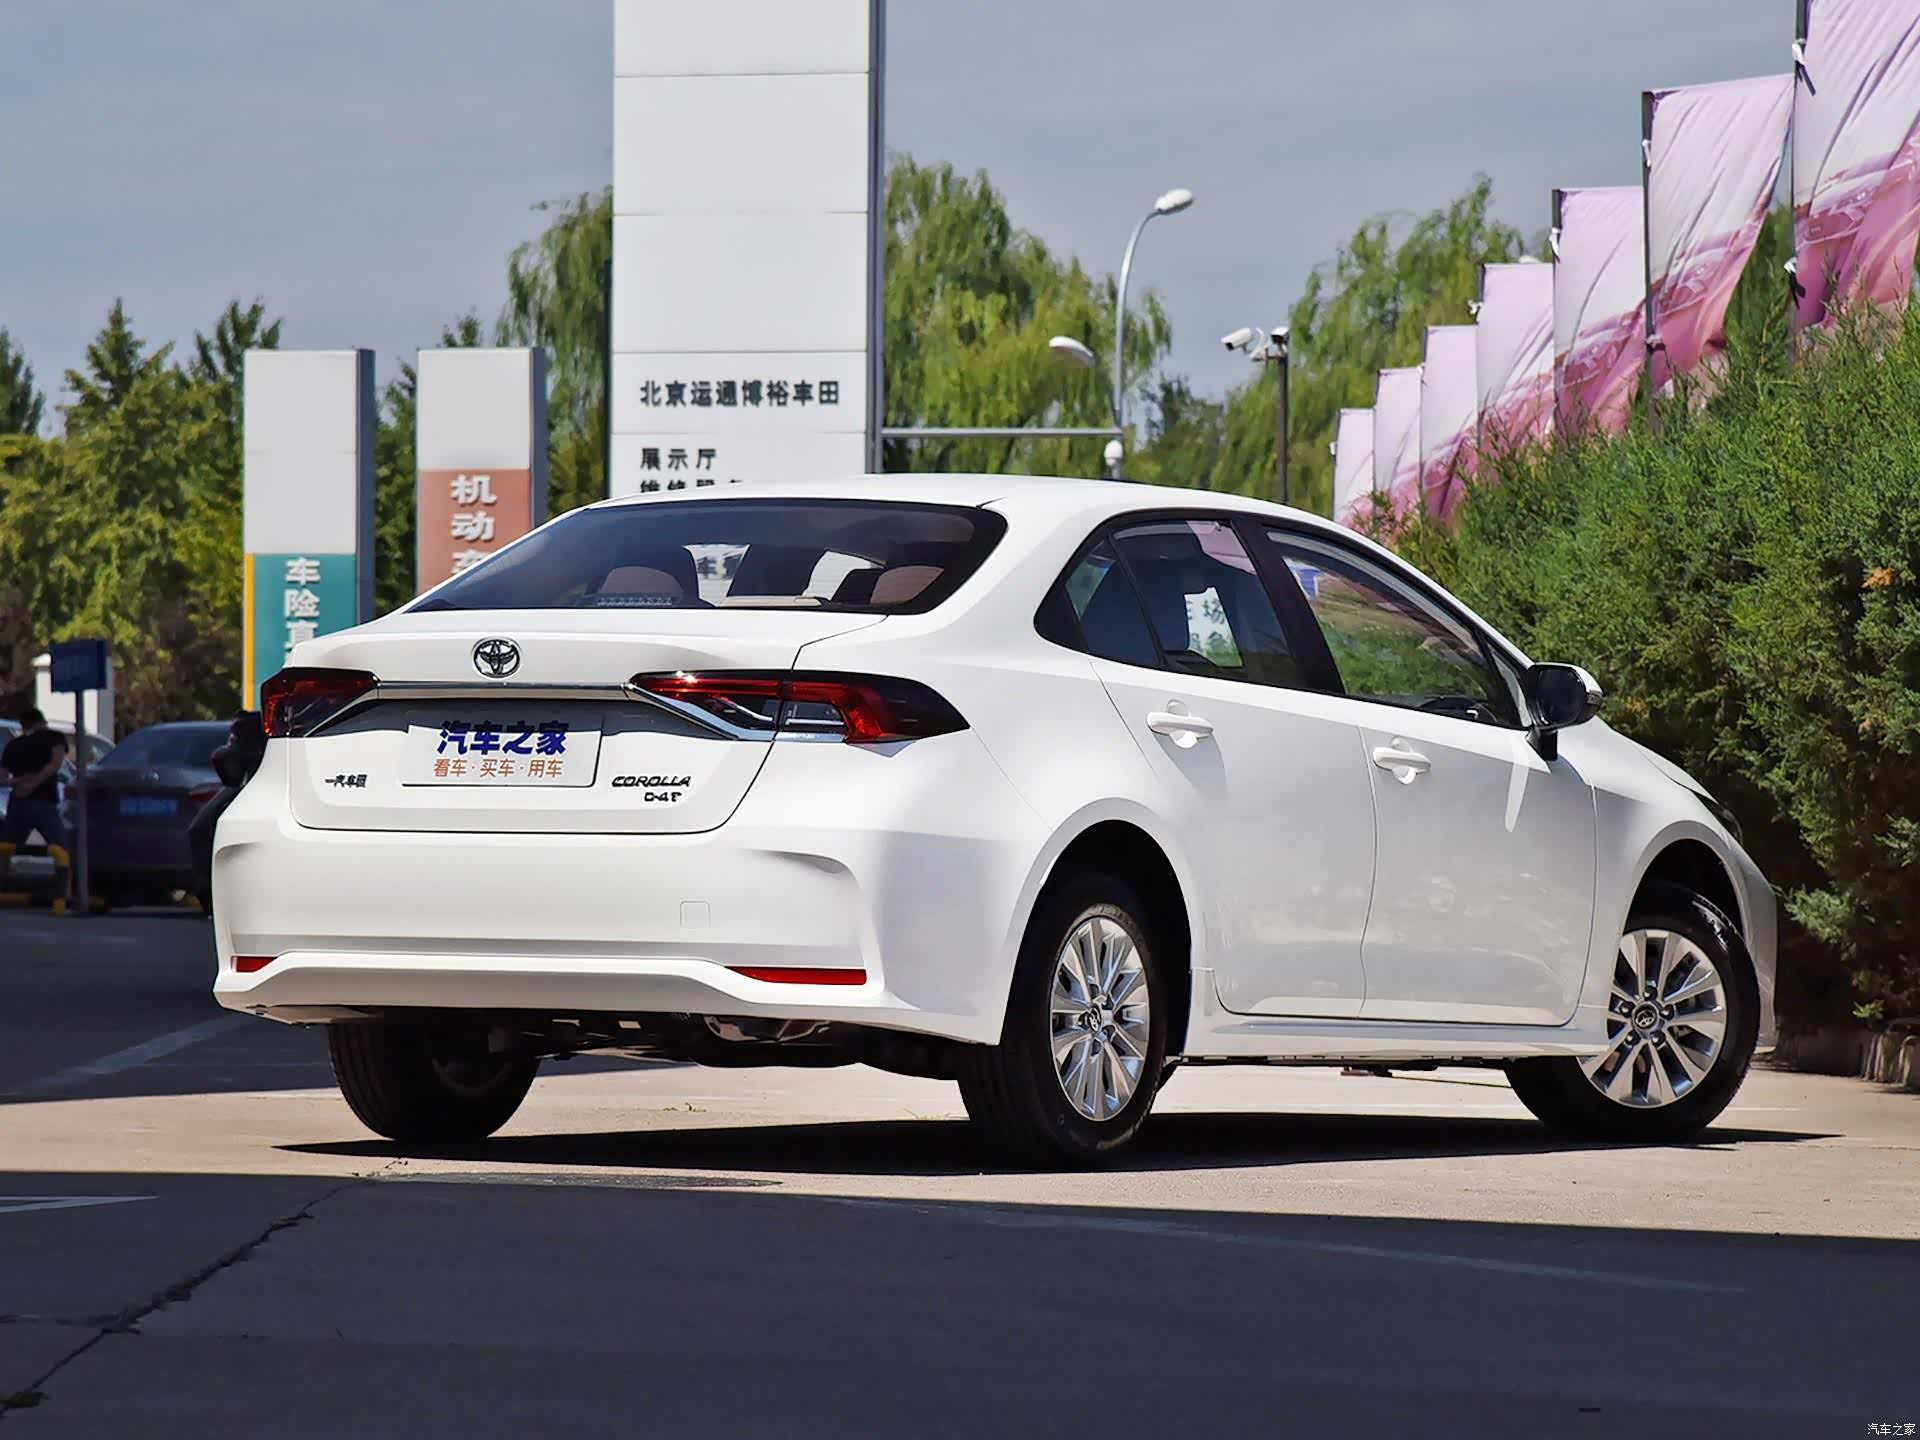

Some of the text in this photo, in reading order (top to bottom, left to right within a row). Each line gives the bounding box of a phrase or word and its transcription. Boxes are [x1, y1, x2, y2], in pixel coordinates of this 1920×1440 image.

[640, 380, 839, 407] 北京运通博裕丰田
[640, 448, 716, 470] 展示厅
[611, 775, 691, 787] COROLLA
